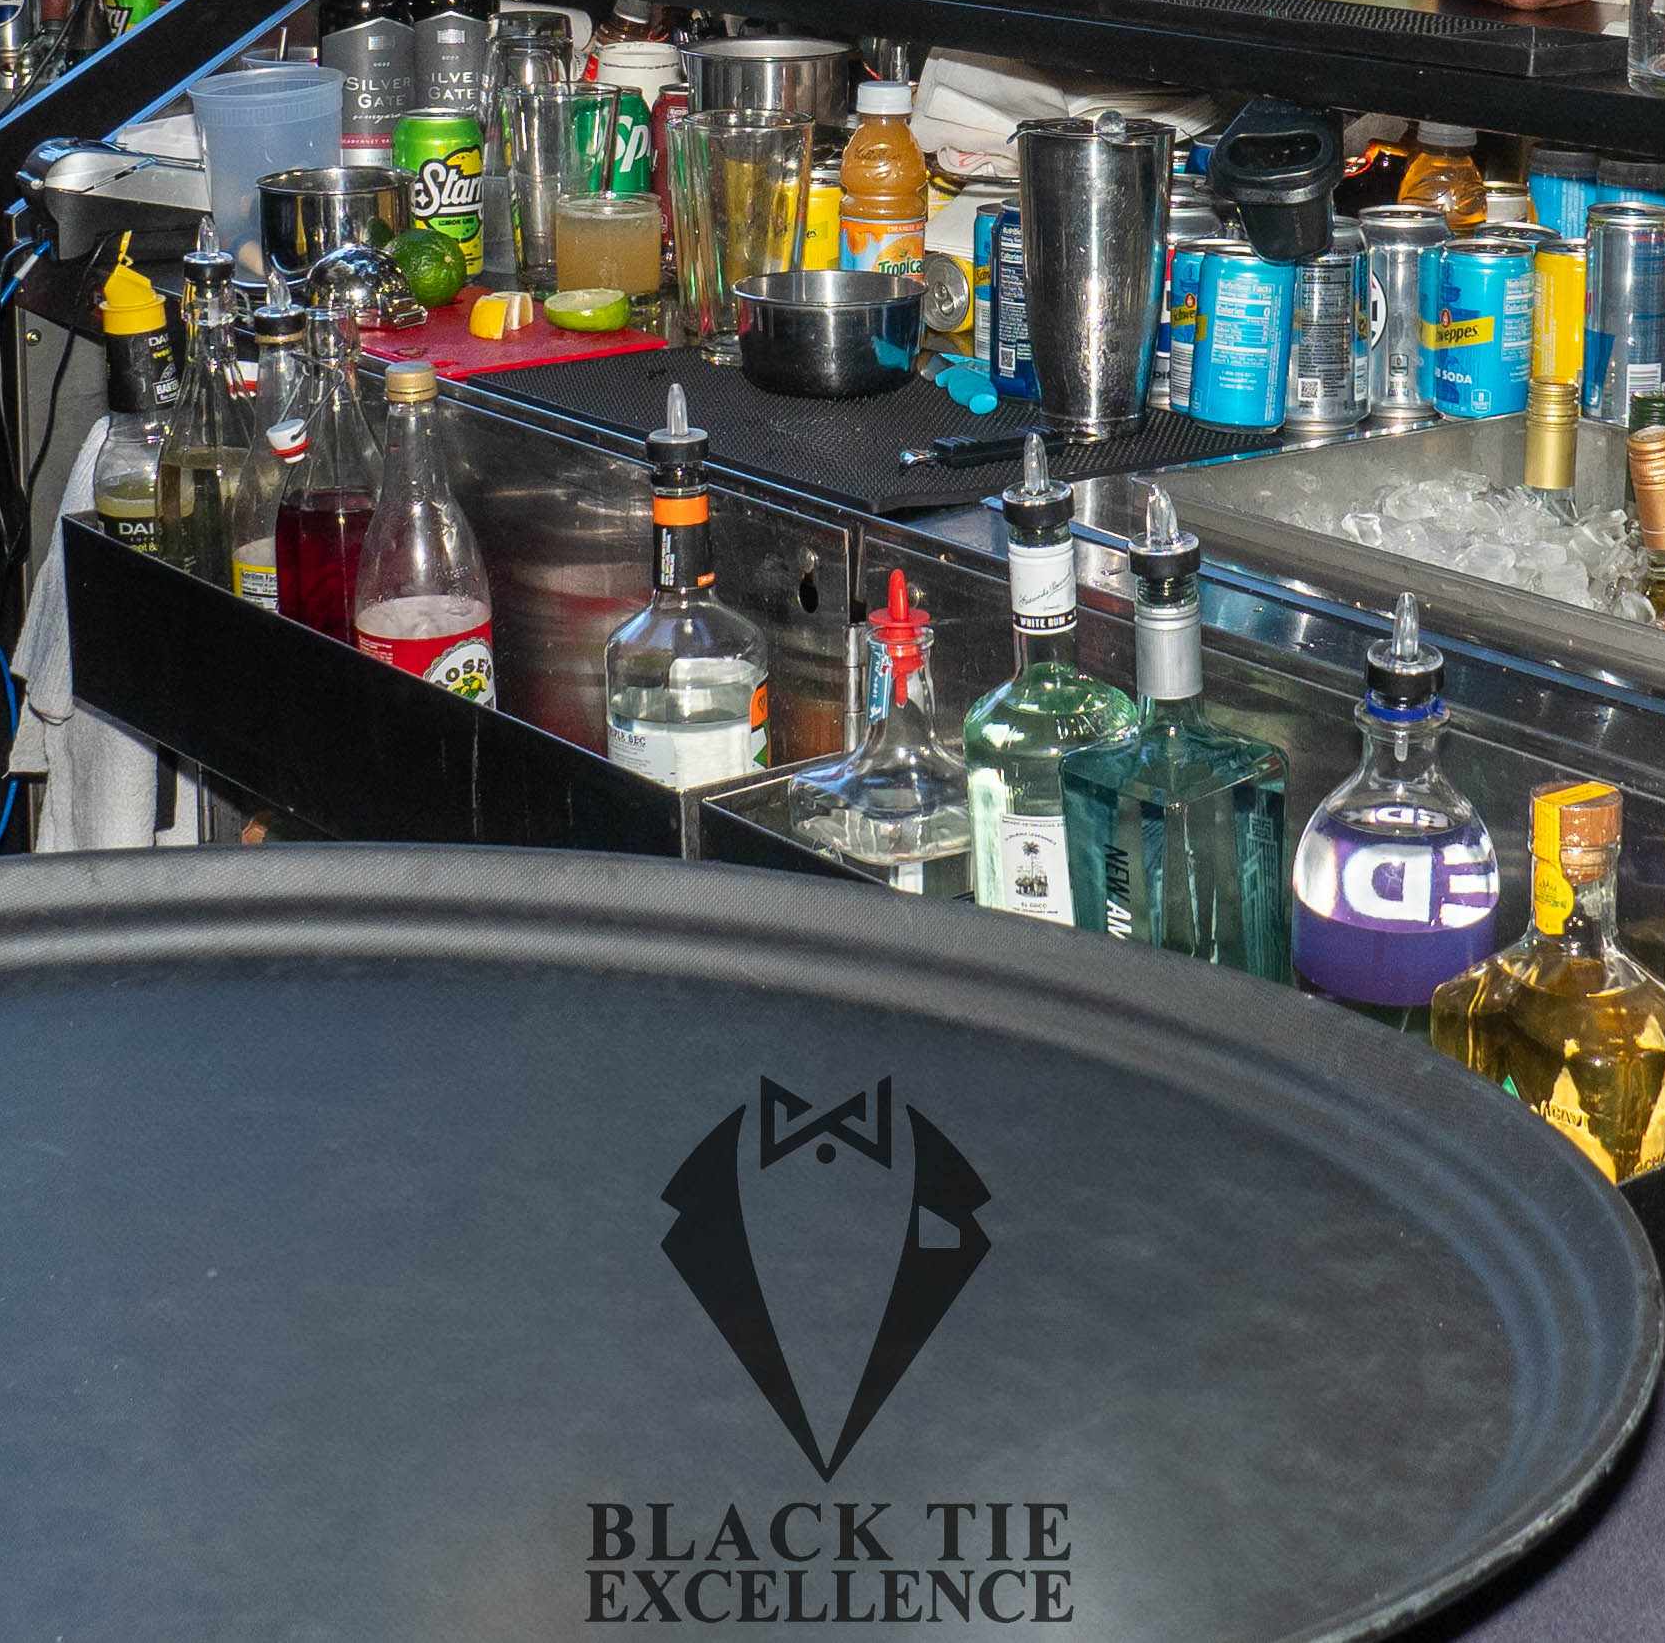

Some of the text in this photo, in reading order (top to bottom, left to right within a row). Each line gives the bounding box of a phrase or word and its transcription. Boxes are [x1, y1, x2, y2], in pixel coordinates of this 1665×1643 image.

[346, 76, 411, 92] SILVER
[357, 93, 407, 109] GATE
[1263, 307, 1271, 317] 0
[1442, 369, 1473, 385] SODA
[1019, 616, 1066, 629] WHITE RUM
[1104, 844, 1131, 903] NEW
